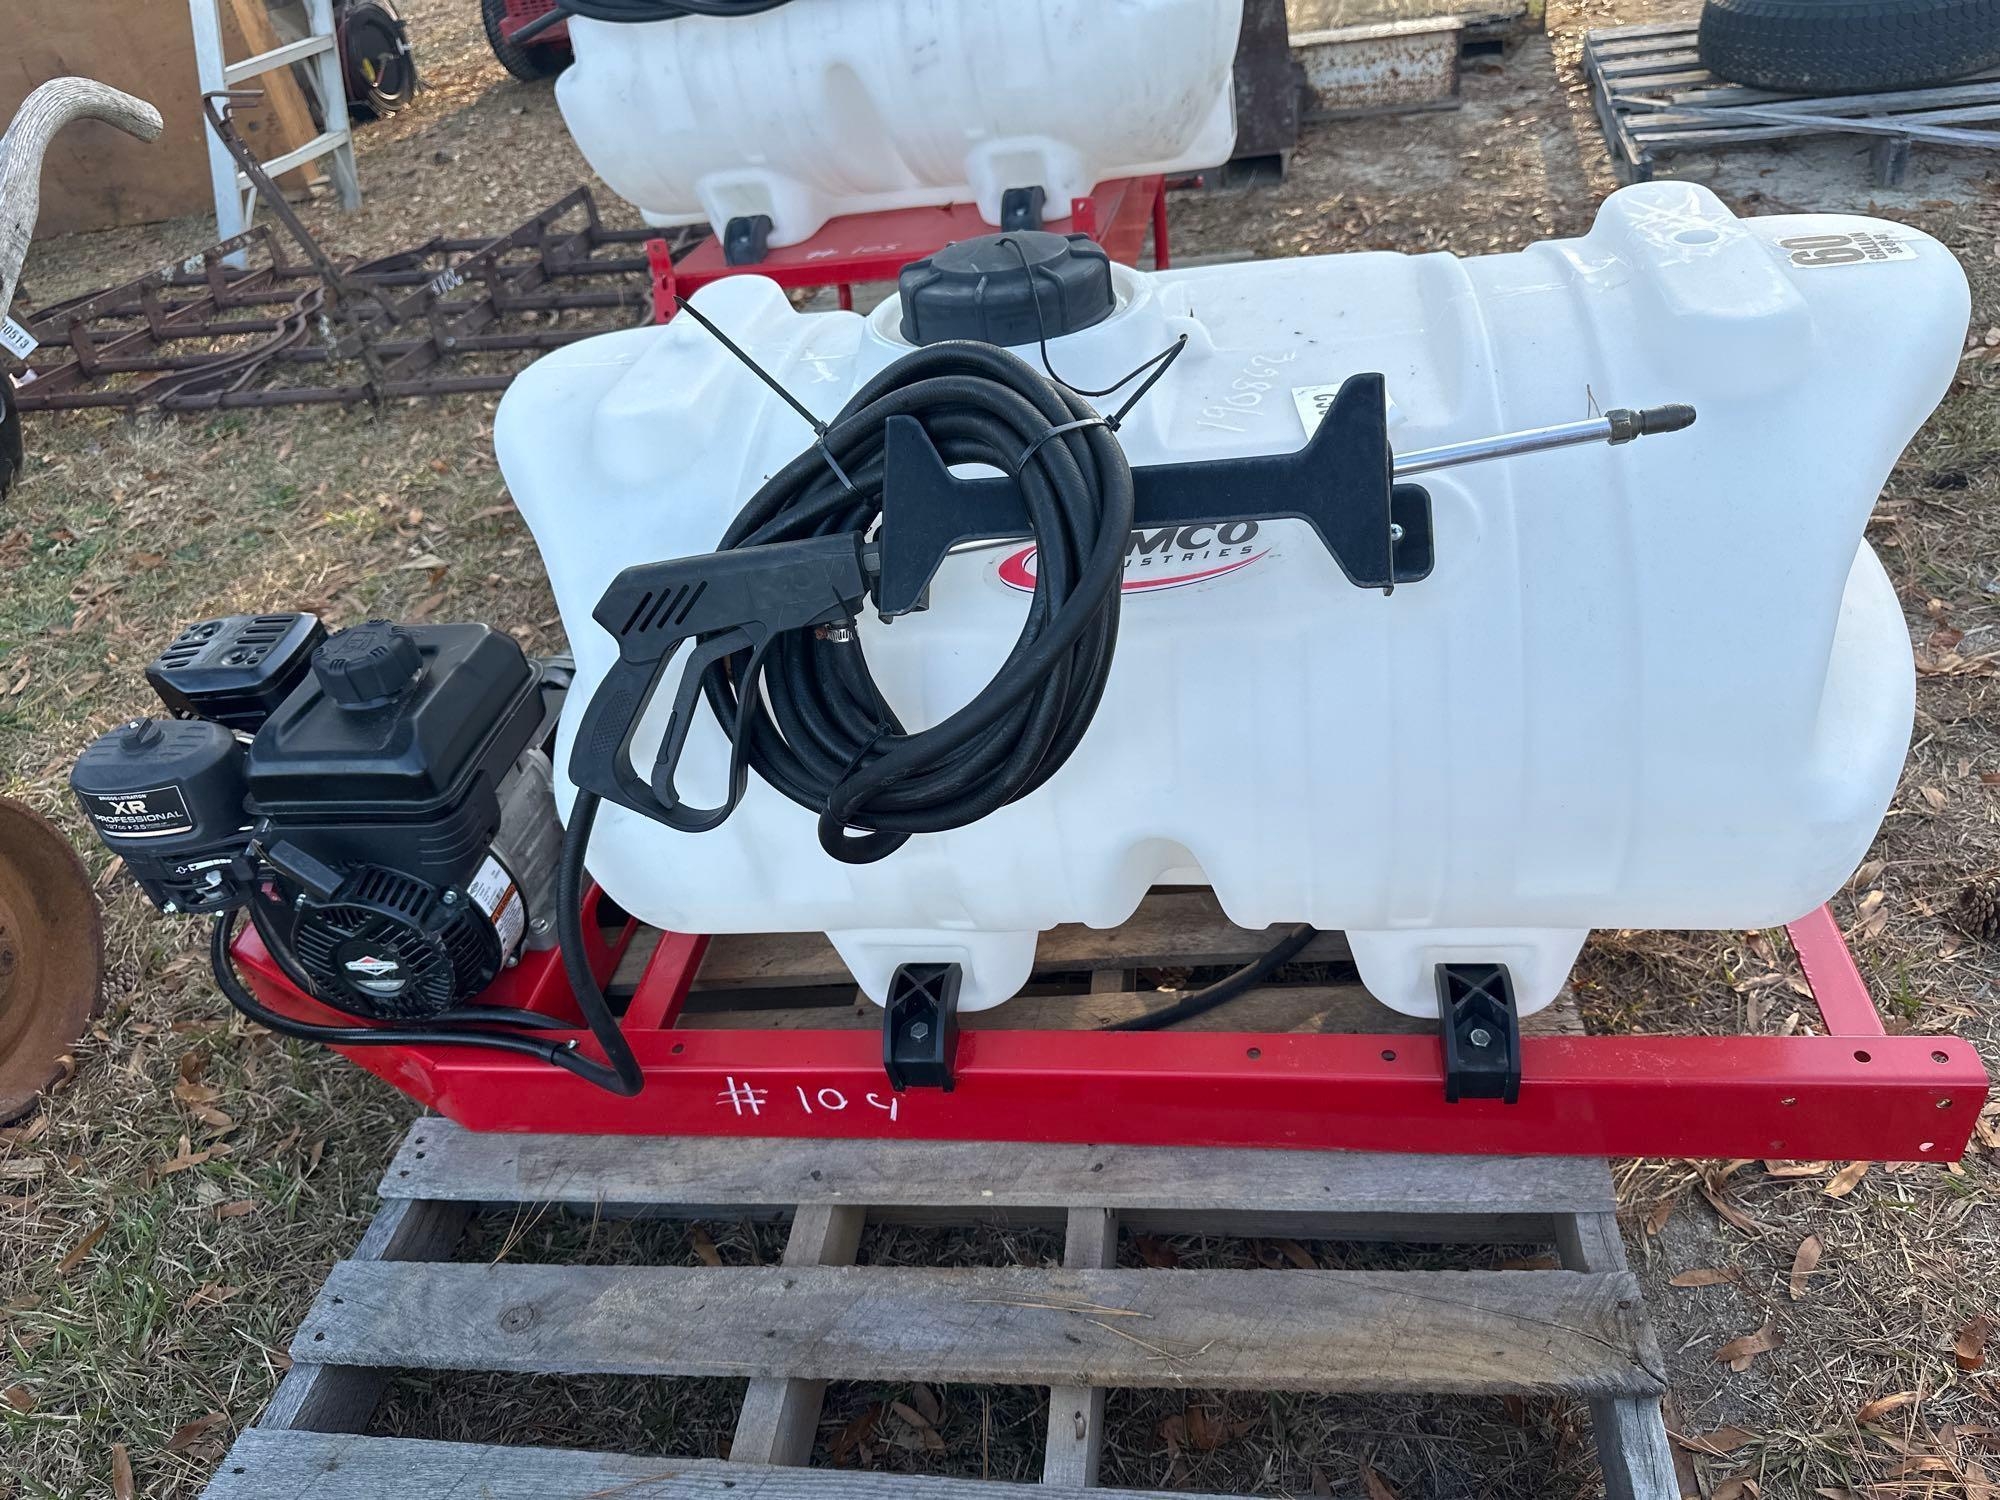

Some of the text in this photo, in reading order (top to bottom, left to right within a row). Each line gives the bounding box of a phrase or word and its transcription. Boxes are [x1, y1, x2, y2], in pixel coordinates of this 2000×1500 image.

[1779, 234, 1866, 265] 60
[1848, 231, 1888, 260] GALLON
[1125, 521, 1259, 557] MCO
[95, 811, 184, 823] PROFESSIONAL
[108, 800, 149, 815] XR
[716, 1076, 768, 1116] #
